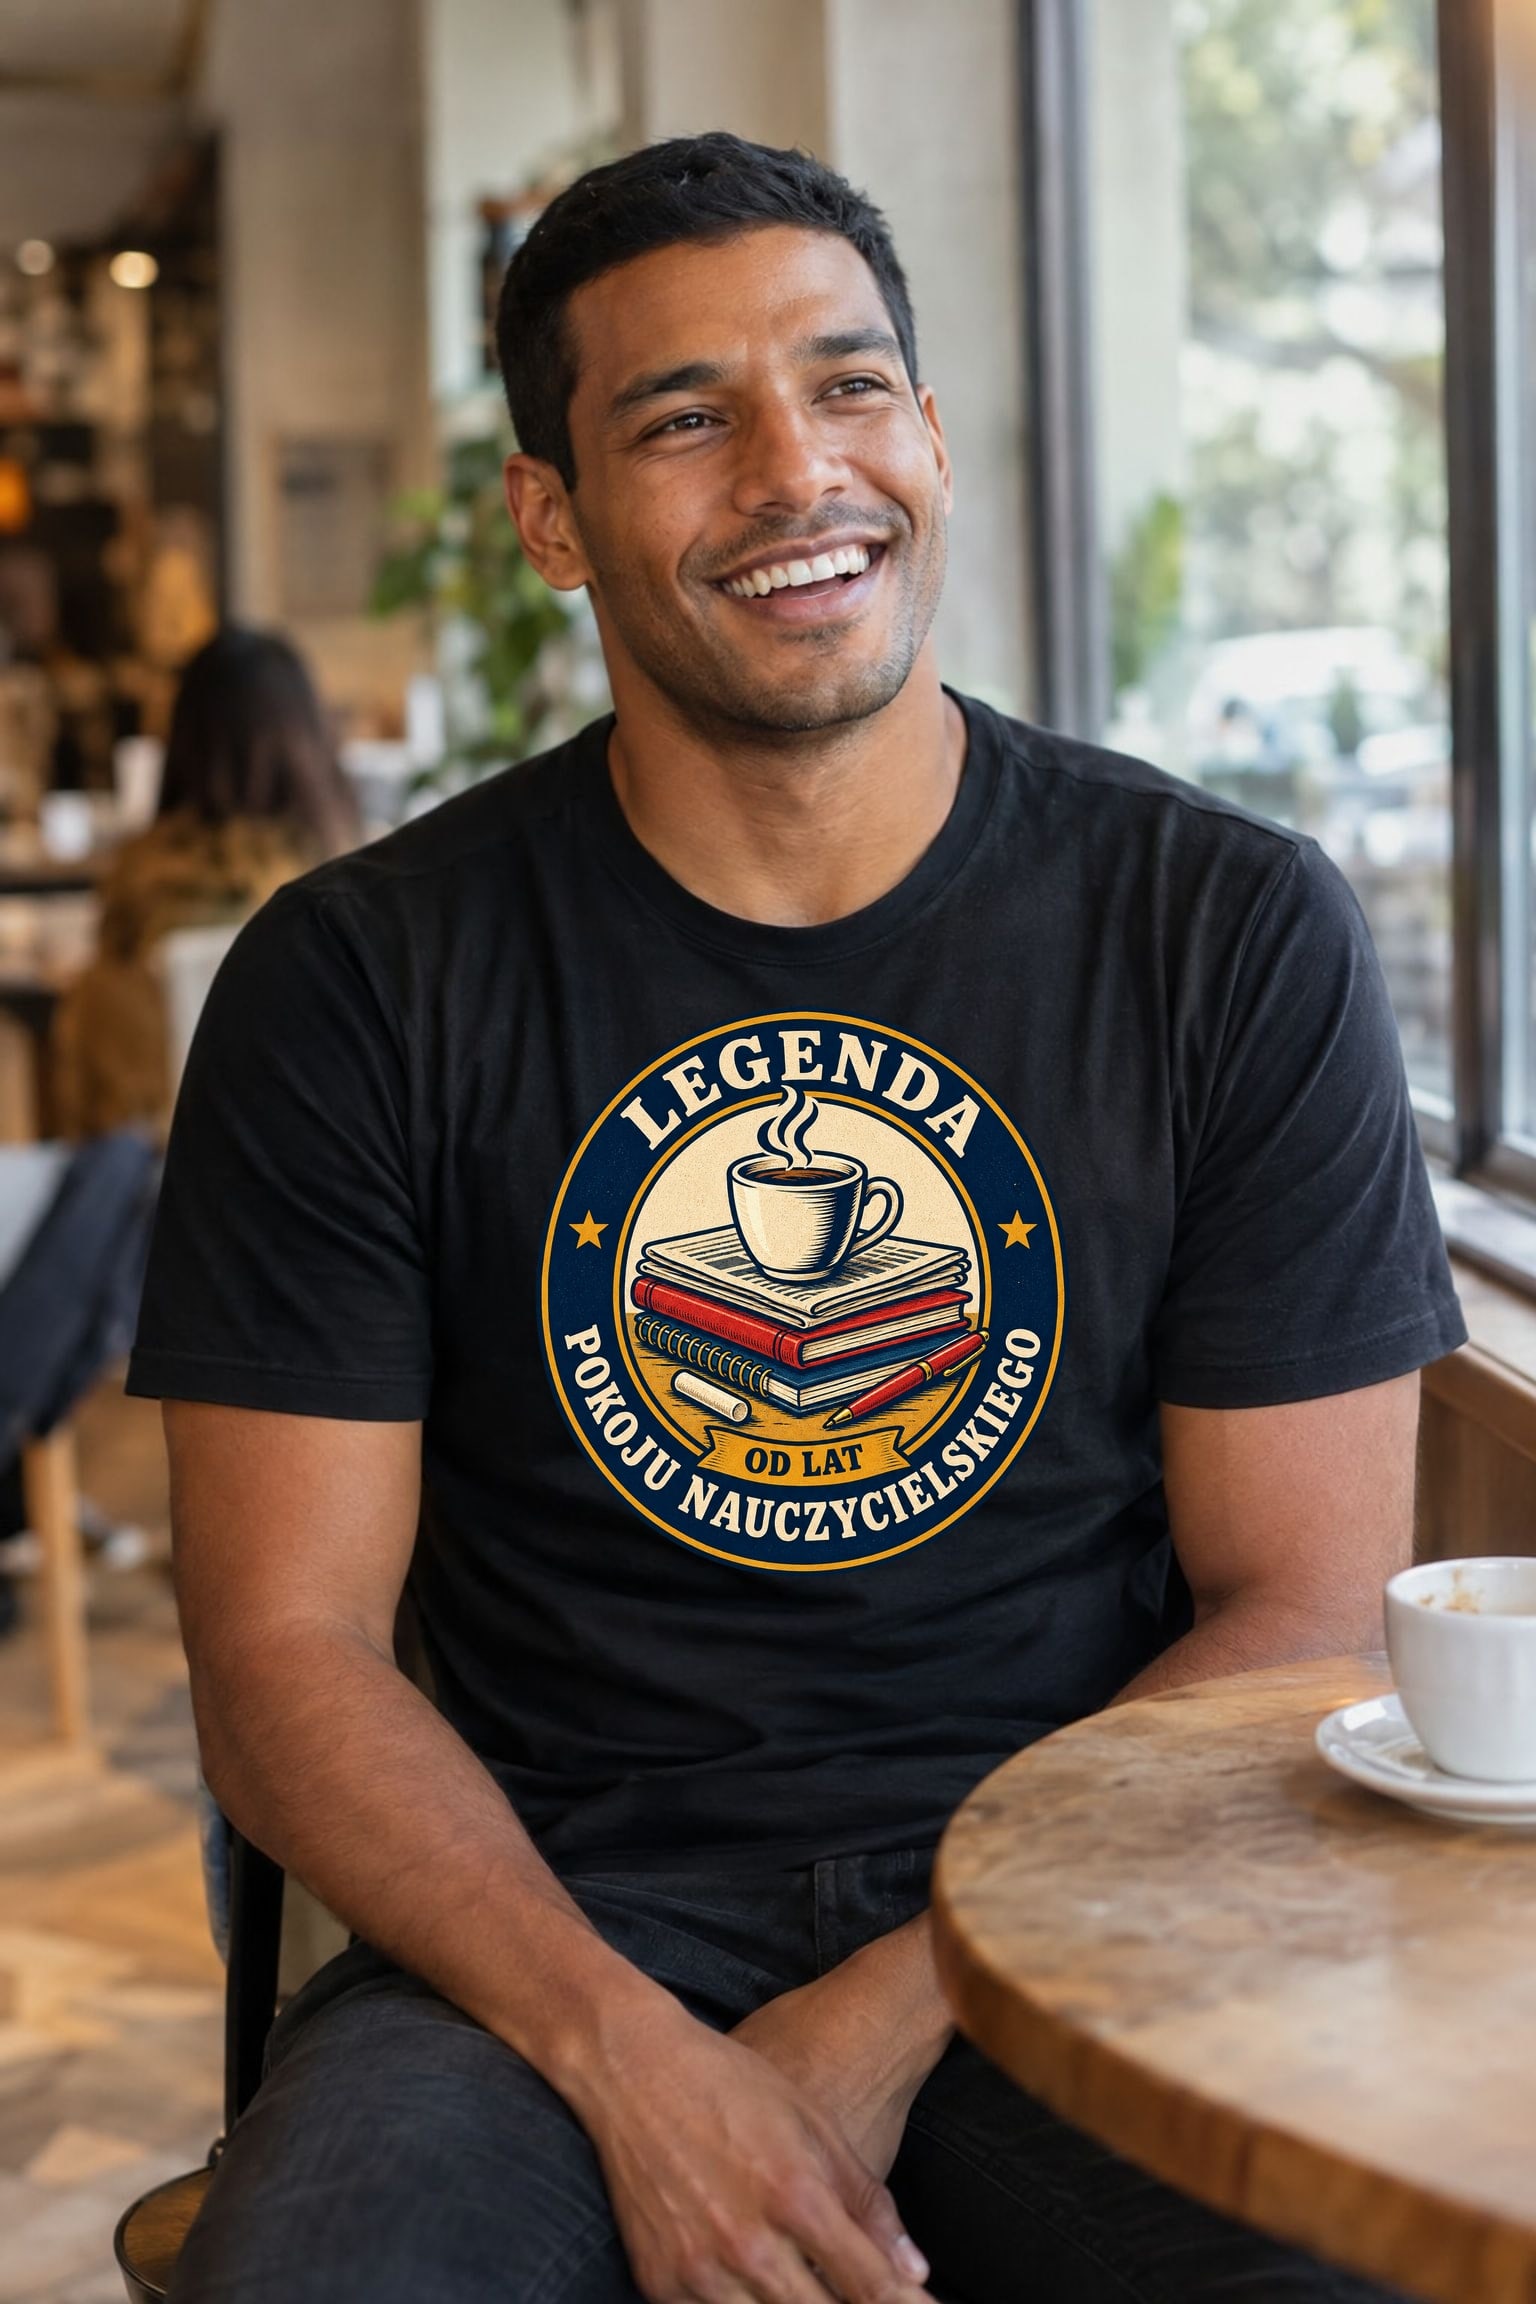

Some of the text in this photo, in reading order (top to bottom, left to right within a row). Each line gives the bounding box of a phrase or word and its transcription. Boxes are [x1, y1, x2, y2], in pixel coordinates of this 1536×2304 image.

[620, 1030, 981, 1158] LEGENDA
[564, 1324, 1041, 1542] POKOJU NAUCZYCIELSKIEGO
[745, 1444, 863, 1477] OD LAT
